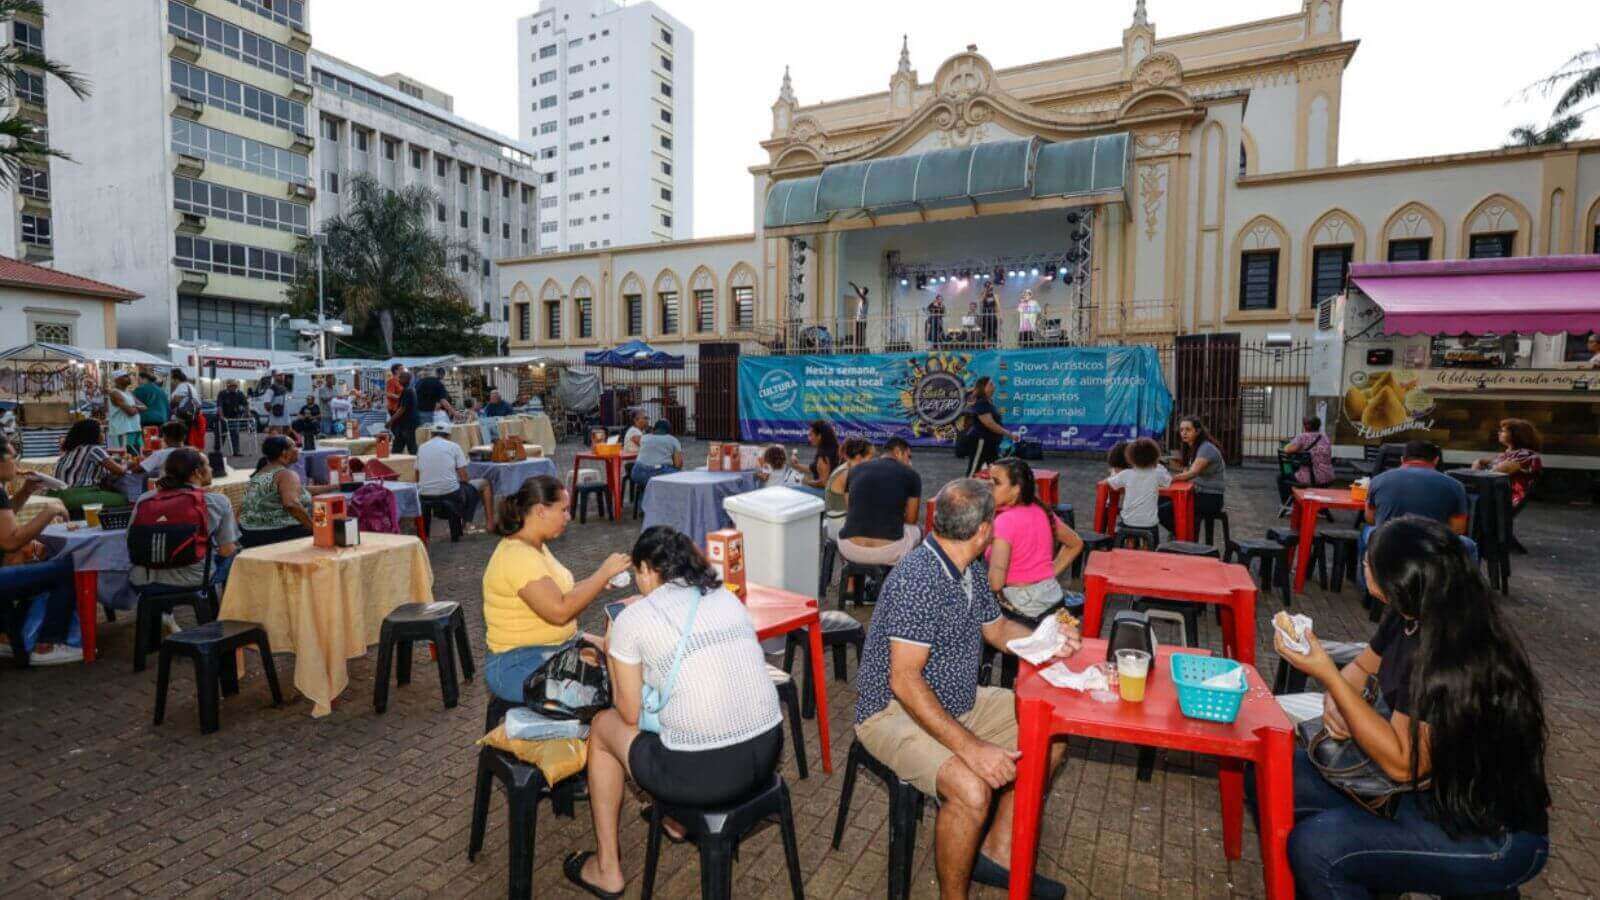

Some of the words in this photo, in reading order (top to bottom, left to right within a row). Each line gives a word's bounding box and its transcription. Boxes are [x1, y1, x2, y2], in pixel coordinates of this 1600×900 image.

[806, 366, 833, 375] Nesta
[837, 366, 880, 376] semana,
[1014, 361, 1048, 371] Shows
[858, 378, 883, 387] local
[1013, 376, 1059, 386] Barracas
[1063, 376, 1076, 385] de
[758, 381, 797, 398] CULTURA
[1013, 392, 1080, 401] Artesanatos
[1012, 407, 1020, 416] E
[1023, 406, 1055, 416] muito
[1057, 405, 1086, 416] mais!
